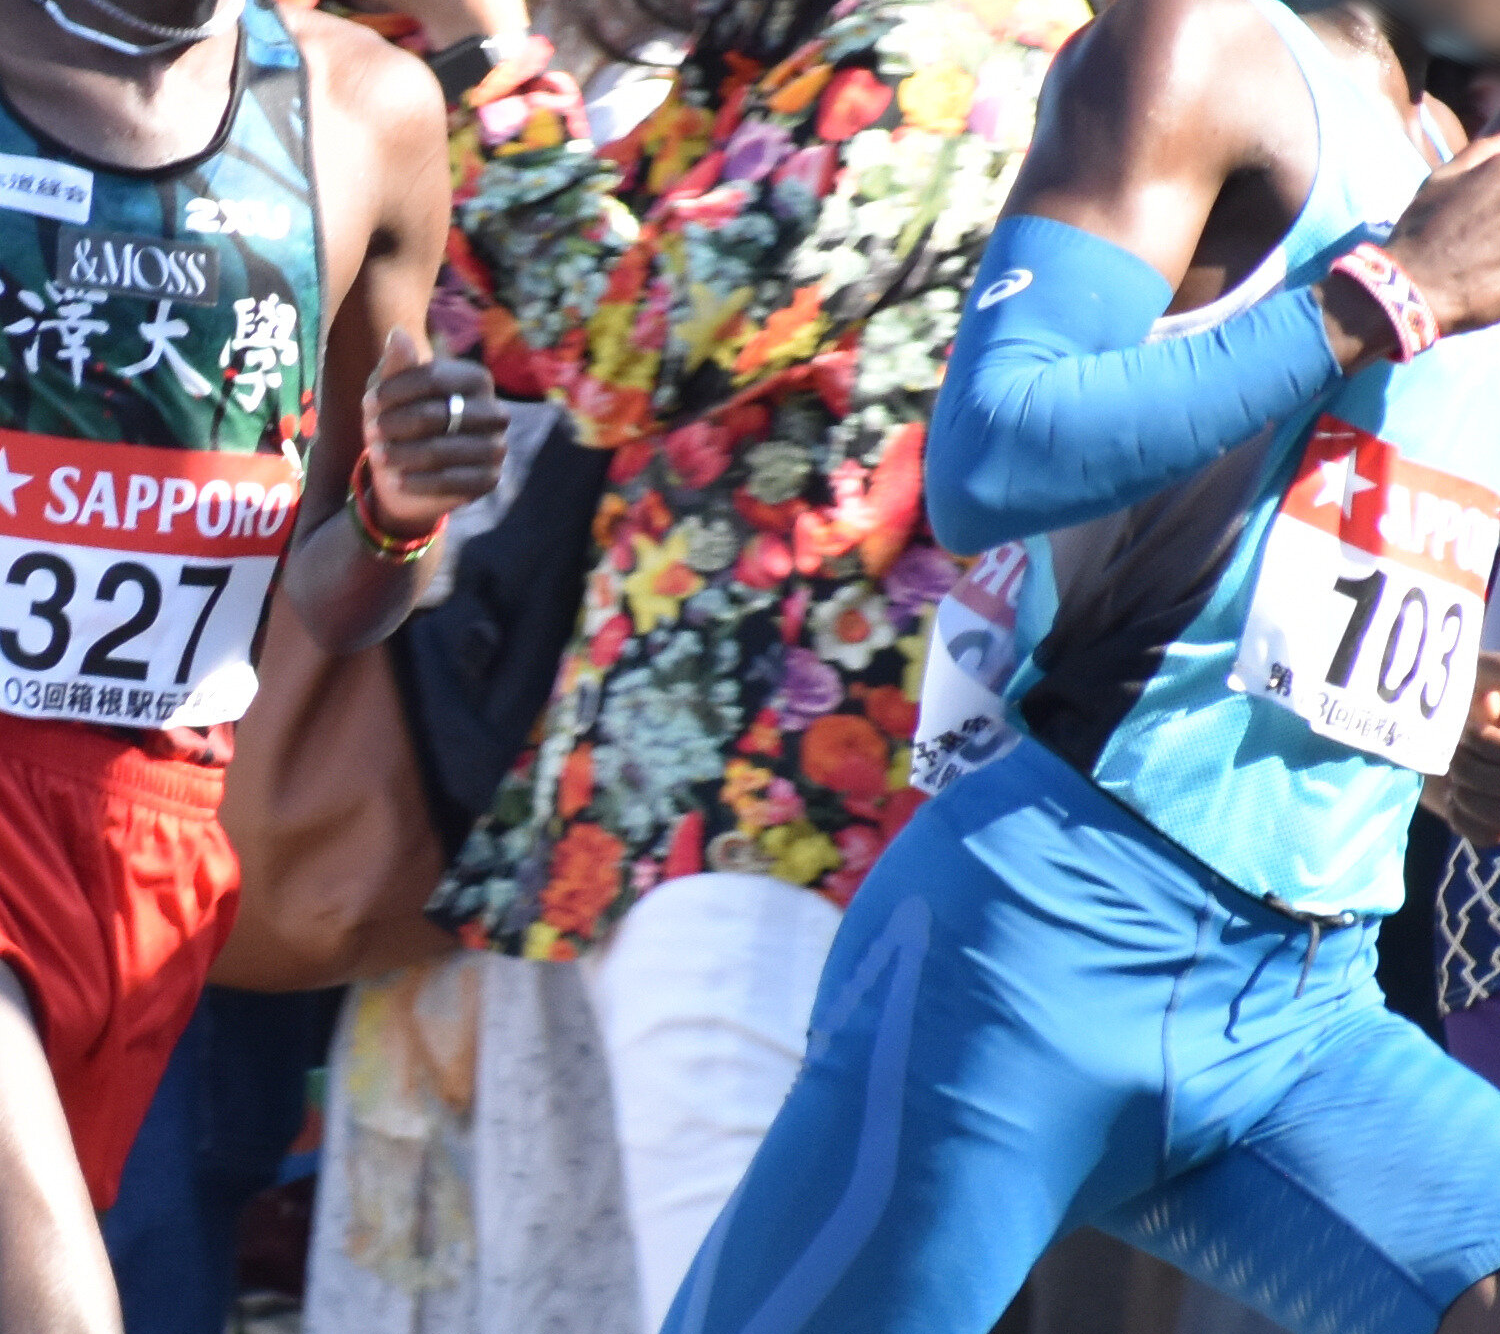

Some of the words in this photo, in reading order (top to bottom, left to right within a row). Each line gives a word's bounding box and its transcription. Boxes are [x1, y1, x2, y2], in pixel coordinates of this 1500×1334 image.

[69, 237, 208, 296] &MOSS
[44, 466, 294, 538] SAPPORO
[1324, 569, 1464, 721] 103
